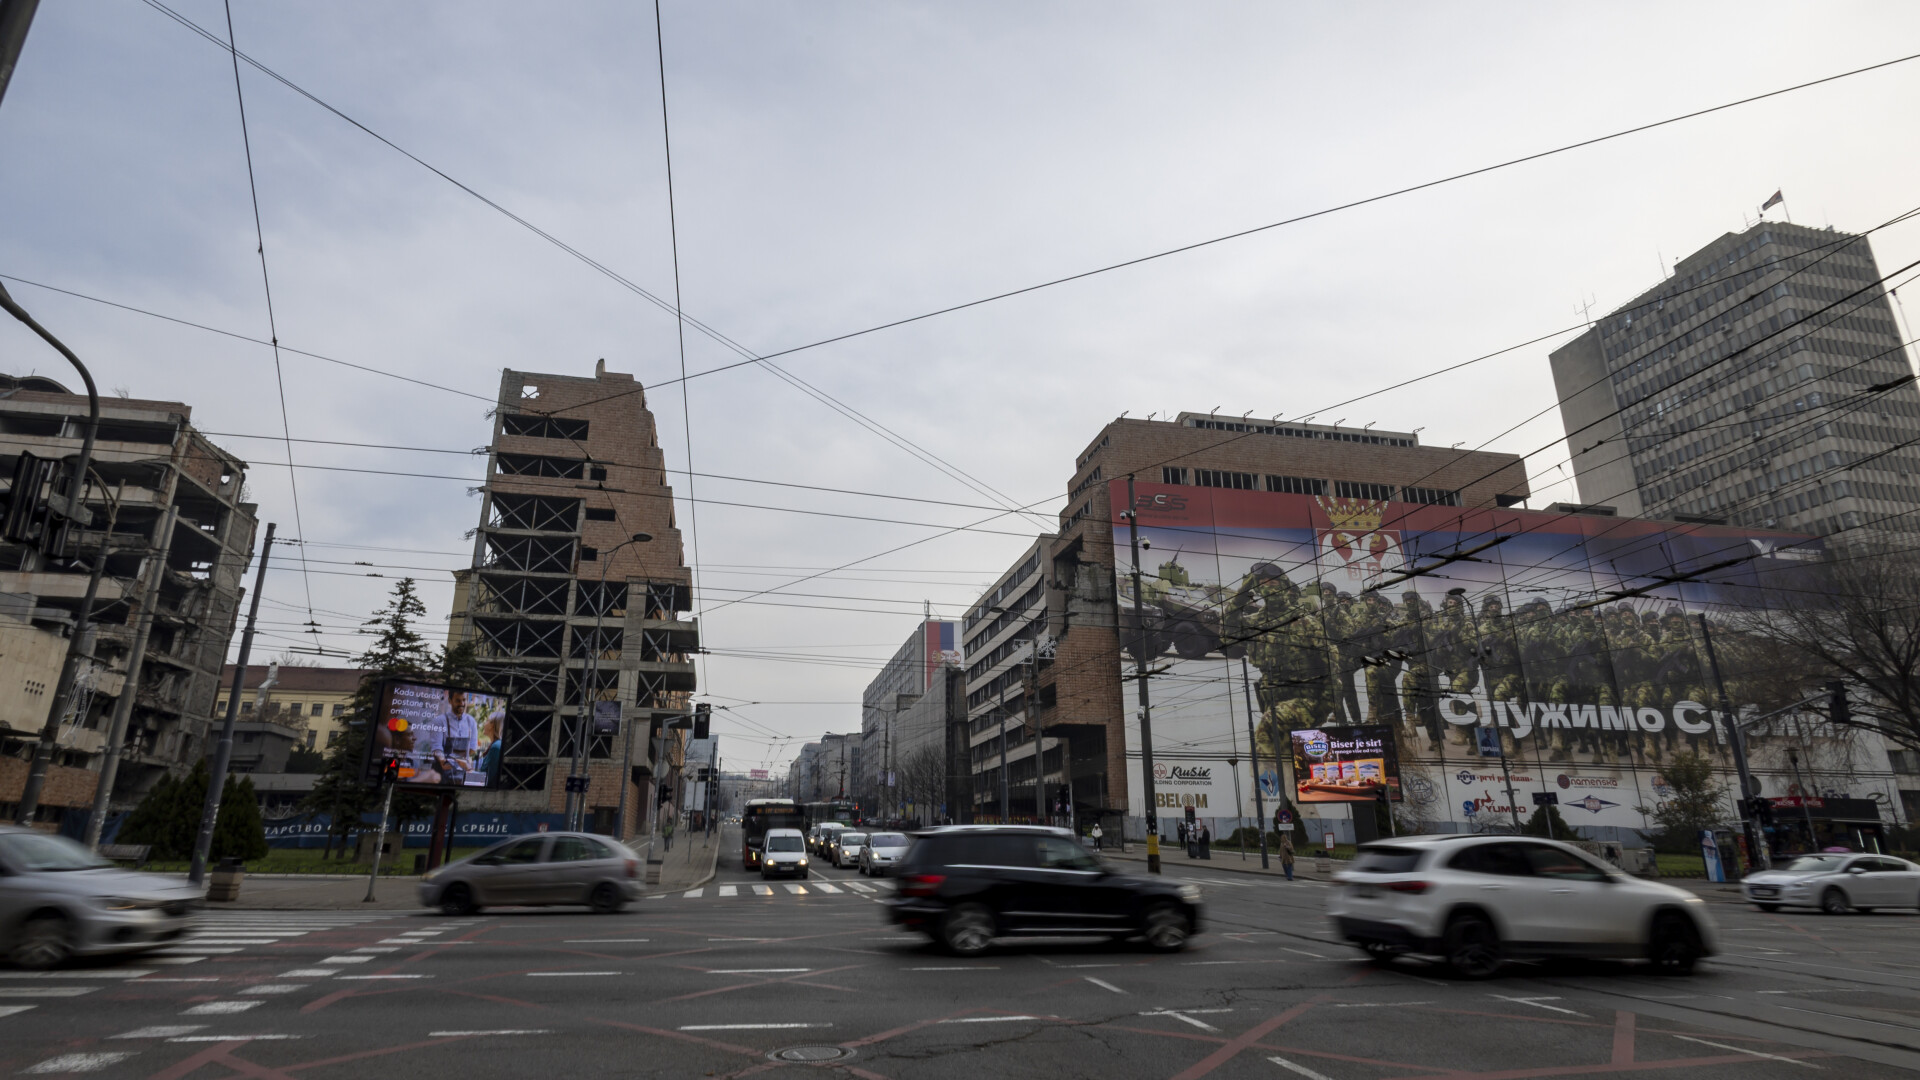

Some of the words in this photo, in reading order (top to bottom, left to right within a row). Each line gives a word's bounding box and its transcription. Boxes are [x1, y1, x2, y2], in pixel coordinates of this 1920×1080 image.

[394, 688, 415, 697] Kada
[416, 692, 441, 700] utorak
[392, 699, 423, 707] postane
[425, 702, 439, 711] tvoj
[390, 708, 420, 717] omiljeni
[1439, 693, 1665, 738] Служимо
[411, 723, 447, 732] priceless
[1330, 740, 1355, 748] Biser
[1355, 739, 1364, 749] je
[1497, 774, 1530, 783] patizan
[1571, 778, 1618, 787] namenska
[462, 823, 508, 834] СРБИЈЕ
